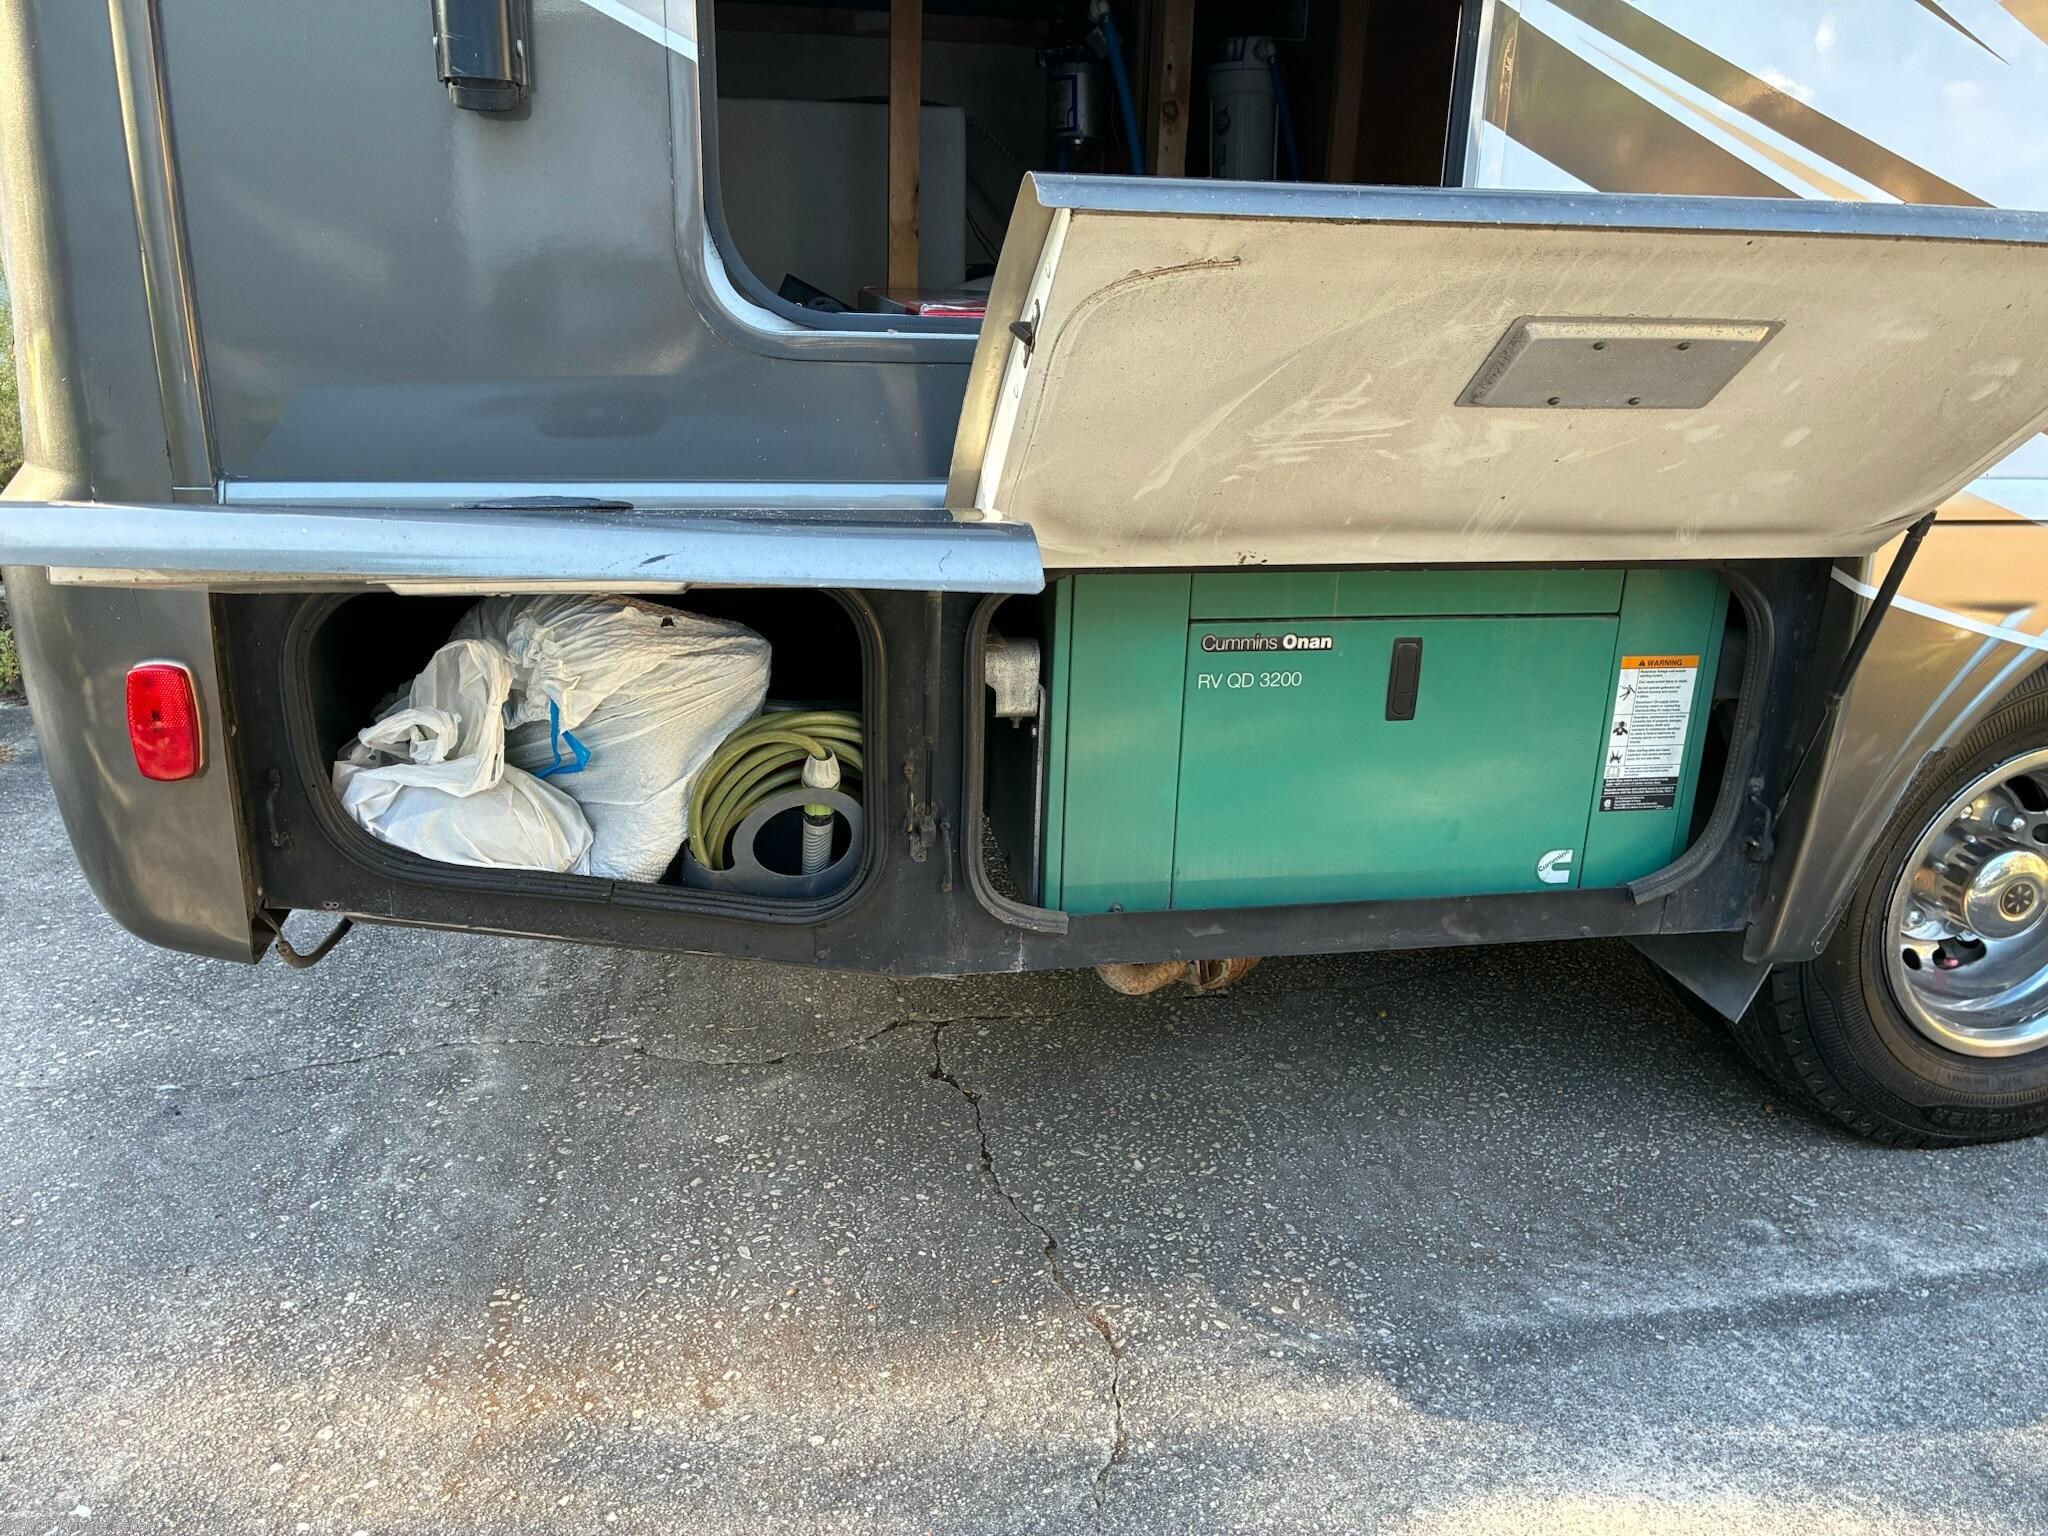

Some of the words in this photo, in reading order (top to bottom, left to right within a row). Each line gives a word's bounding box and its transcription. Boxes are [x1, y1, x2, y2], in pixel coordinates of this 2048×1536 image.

[1202, 634, 1278, 651] Cummins
[1282, 633, 1333, 650] Onan
[1647, 658, 1683, 667] WARNING
[1197, 673, 1223, 689] RV
[1227, 672, 1255, 689] QD
[1259, 671, 1302, 687] 3200
[1538, 850, 1570, 872] Cummins
